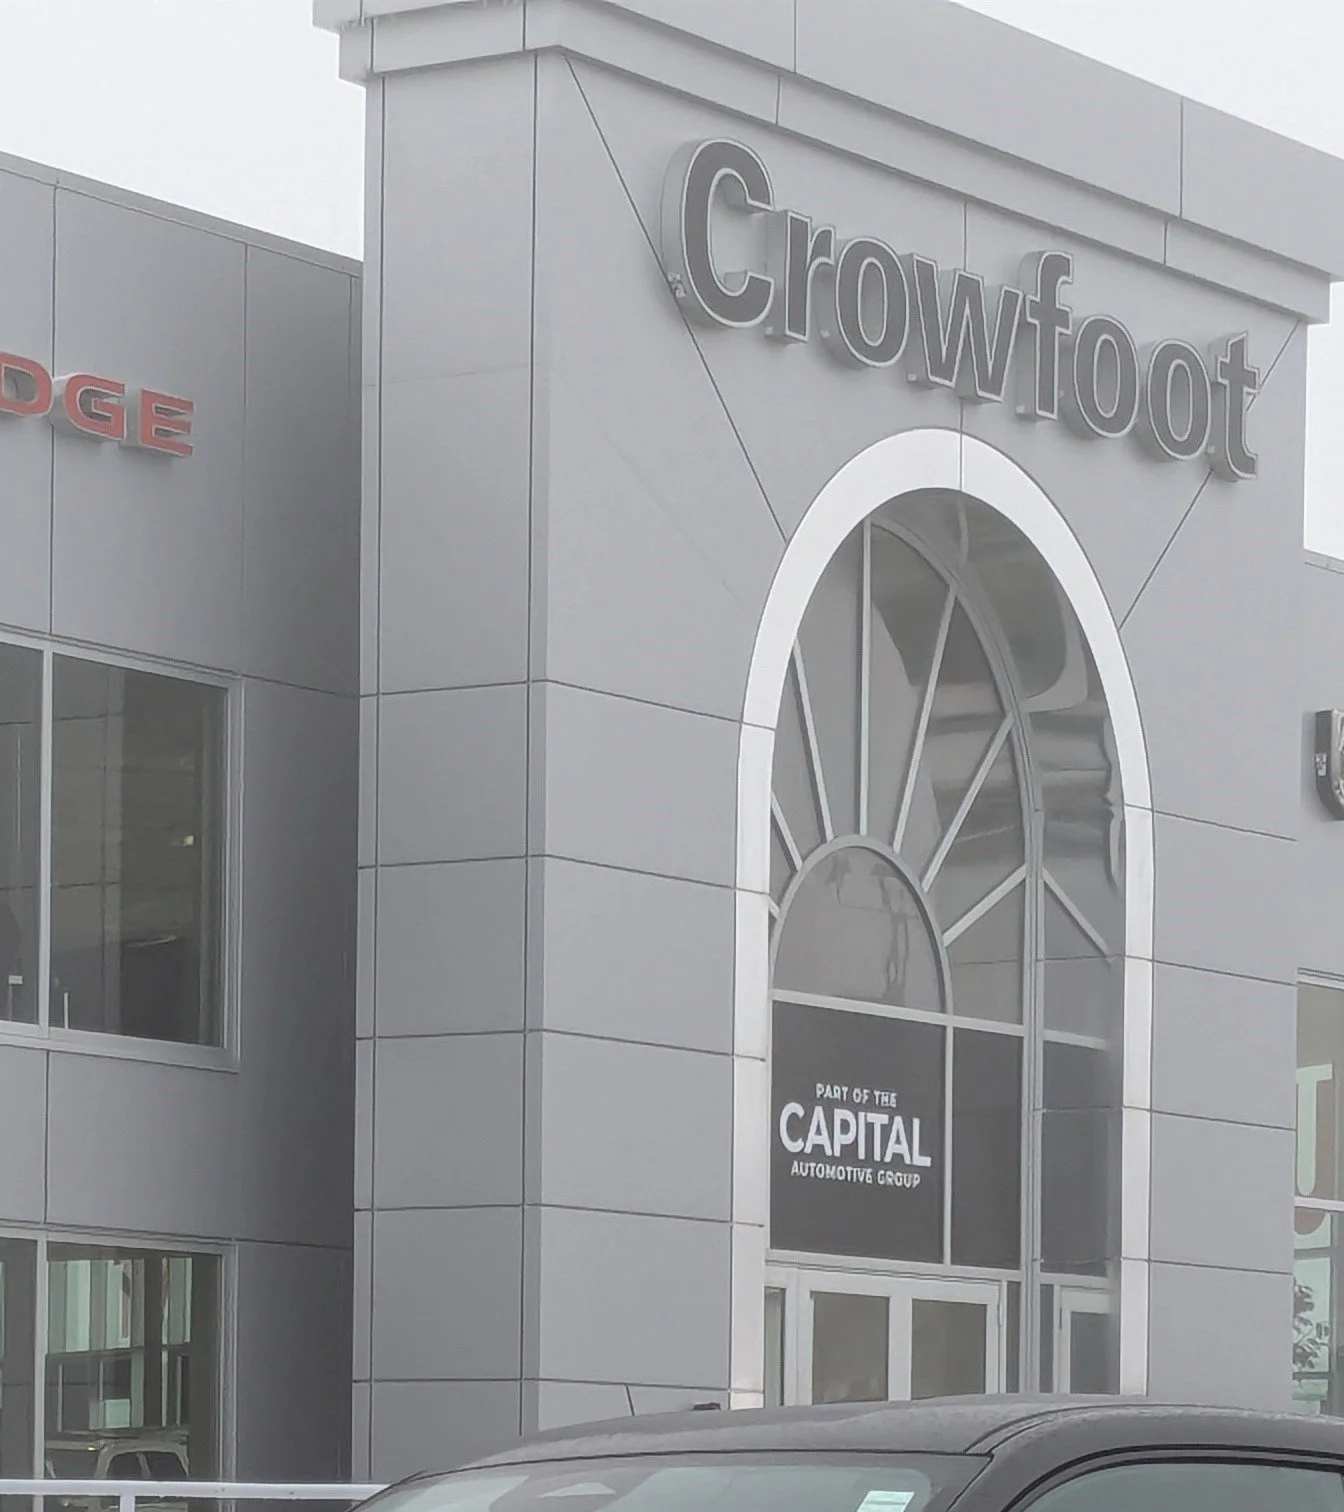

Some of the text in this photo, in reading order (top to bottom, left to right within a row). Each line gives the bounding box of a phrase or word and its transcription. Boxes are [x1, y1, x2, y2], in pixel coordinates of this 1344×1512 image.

[672, 136, 1260, 482] Crowfoot
[815, 1082, 898, 1108] PART OF THE
[779, 1101, 932, 1168] CAPITAL
[790, 1160, 921, 1189] AUTOMOTIVE GROUP
